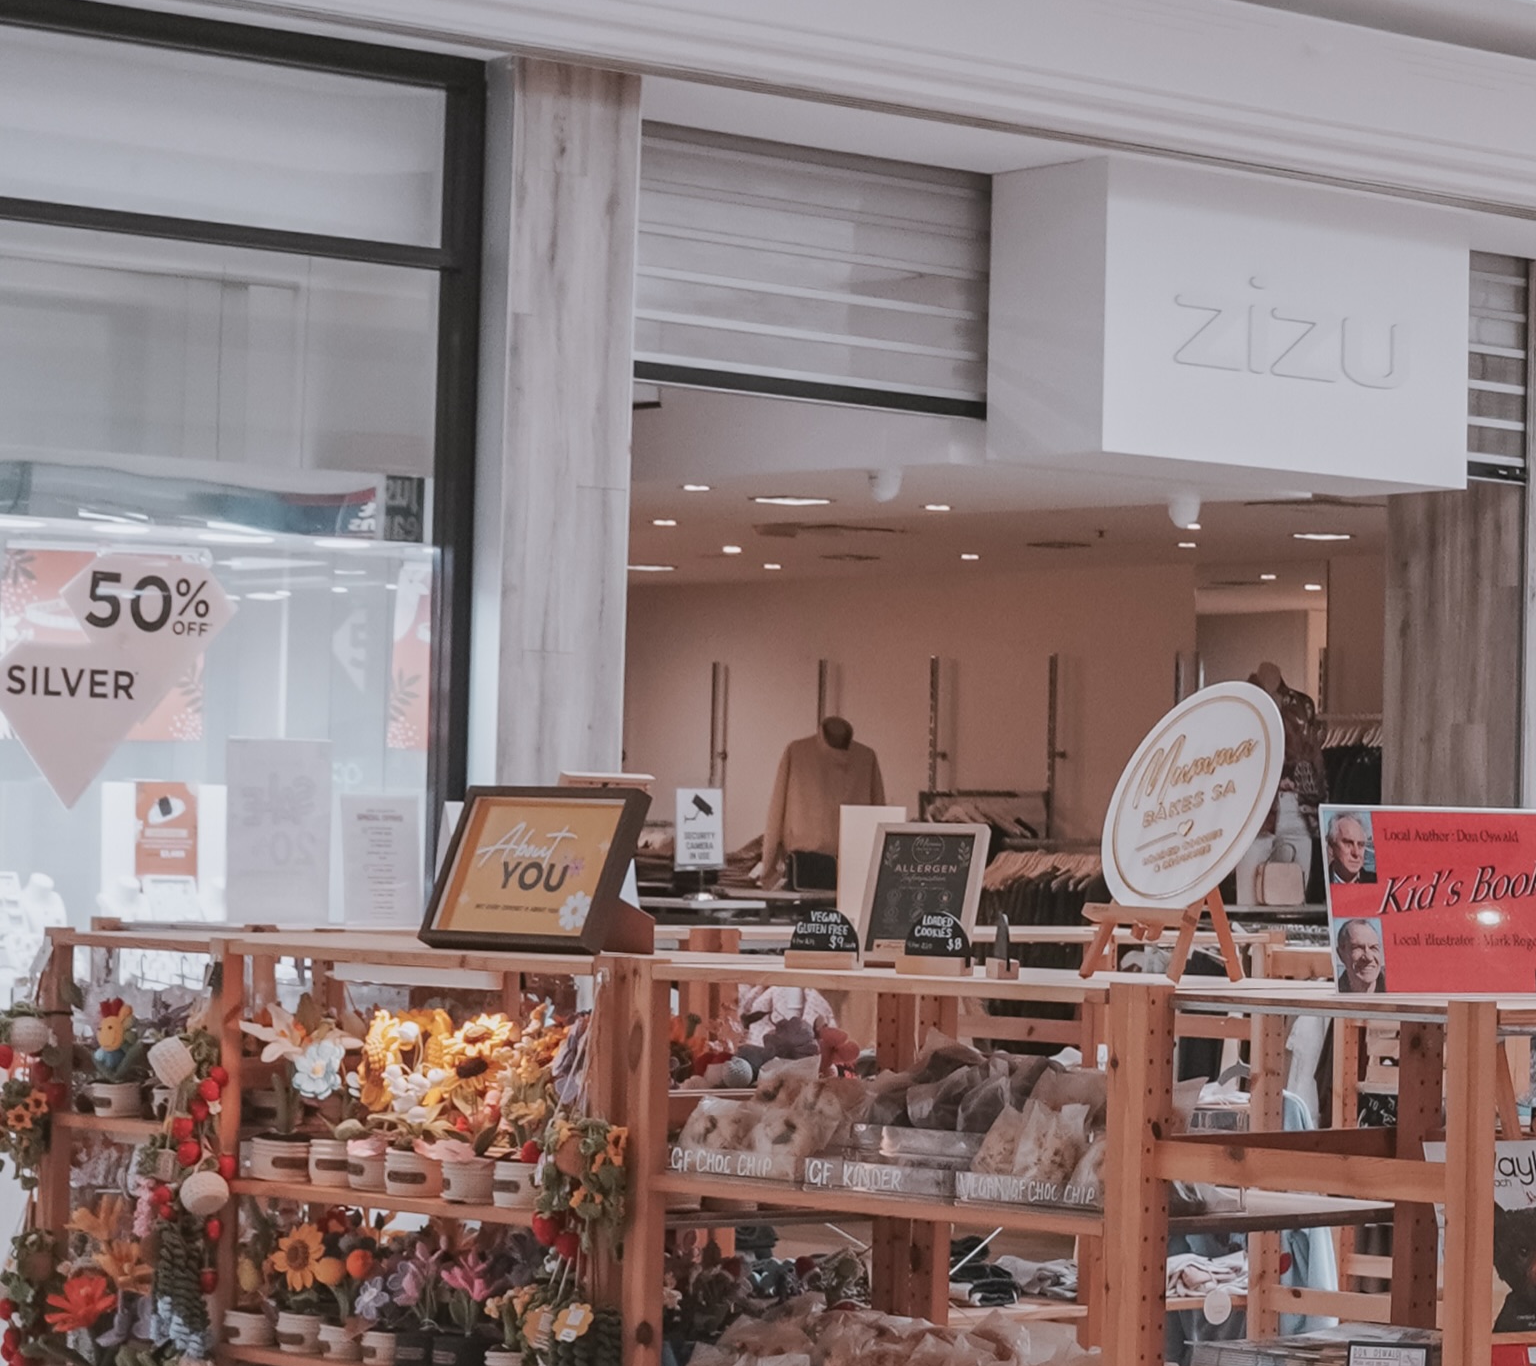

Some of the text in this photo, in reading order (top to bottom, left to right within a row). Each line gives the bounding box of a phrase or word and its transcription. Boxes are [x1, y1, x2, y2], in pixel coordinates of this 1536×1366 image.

[85, 570, 209, 632] 50%
[1142, 779, 1236, 828] BAKES SA
[1383, 828, 1410, 842] Local
[1456, 829, 1479, 843] Don
[501, 860, 569, 892] YOU
[894, 863, 957, 873] ALLERGEN
[1377, 868, 1463, 914] Kid's
[796, 922, 849, 935] GLUTEN FREE
[810, 910, 842, 923] VEGAN
[914, 925, 952, 938] COOKIES
[671, 1147, 772, 1176] GF CHOC CHIP
[1028, 1180, 1058, 1202] CHOC
[1063, 1185, 1095, 1204] CHIP
